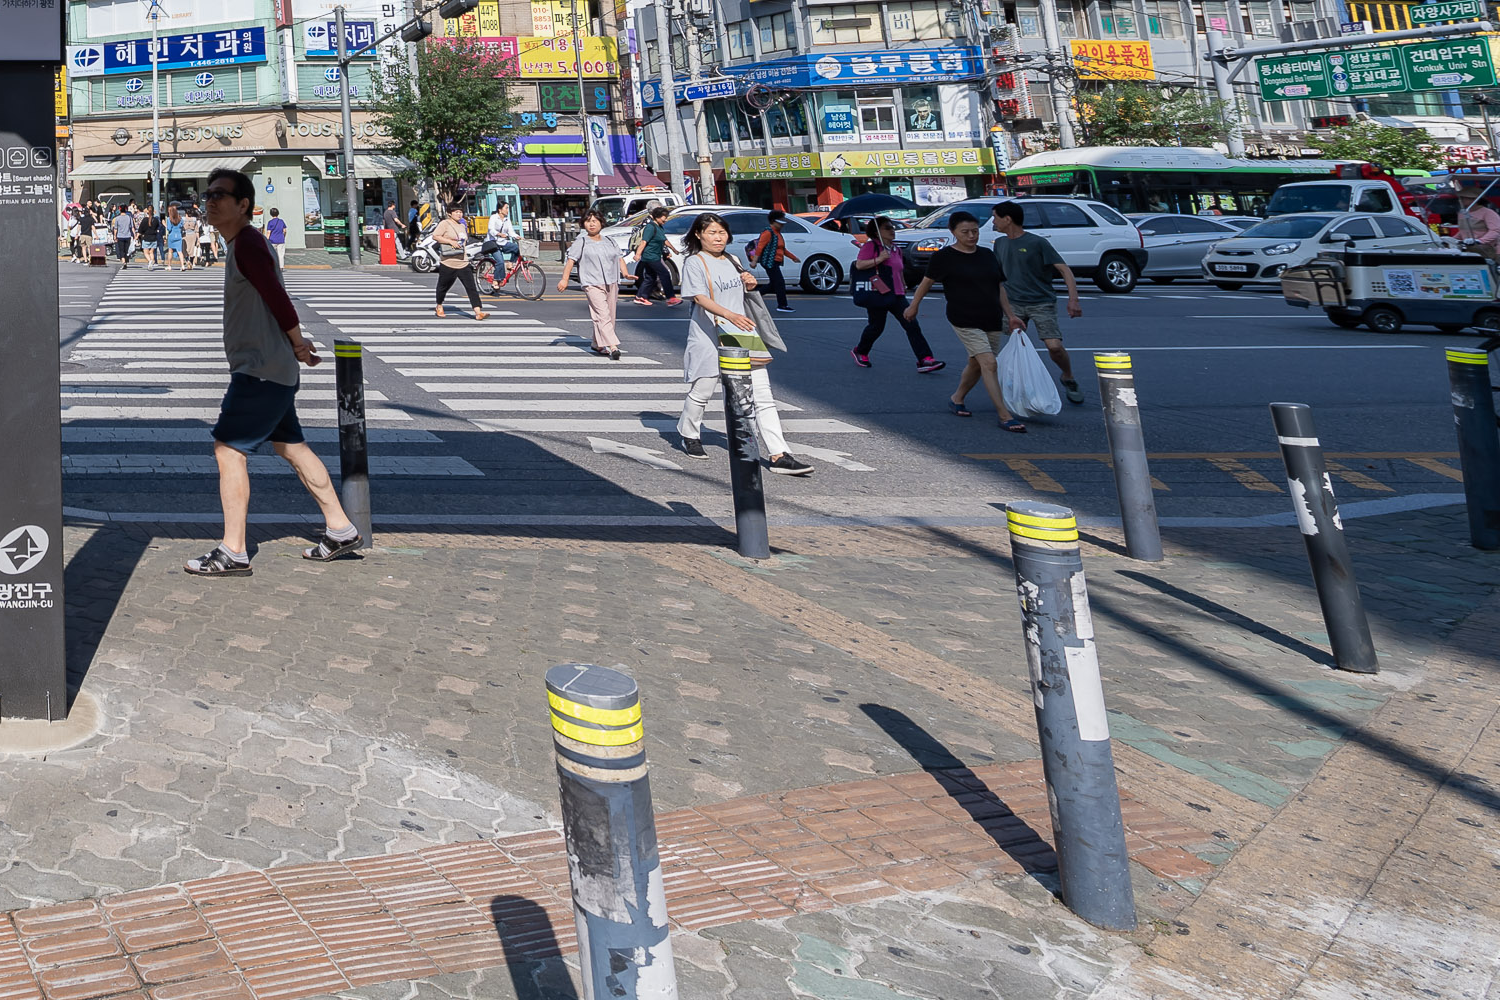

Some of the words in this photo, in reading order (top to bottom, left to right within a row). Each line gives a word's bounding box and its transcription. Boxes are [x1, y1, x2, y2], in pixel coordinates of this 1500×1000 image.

[2, 0, 39, 9] 가치더하기
[40, 0, 55, 9] 광진
[1413, 1, 1477, 20] 자양사거리
[481, 19, 499, 31] 4088
[1077, 43, 1150, 67] 성인용품점
[1349, 52, 1370, 64] 성남
[1409, 44, 1483, 62] 건대입구역
[1261, 59, 1323, 76] 동서울터미널
[1413, 63, 1445, 73] Konkuk
[1448, 61, 1468, 72] Univ
[1472, 59, 1488, 69] Stn
[1349, 69, 1402, 83] 잠실대교
[197, 125, 244, 143] JOURS
[288, 122, 332, 137] TOUS
[334, 122, 356, 137] ls
[748, 155, 811, 171] 시민동물병원
[865, 150, 980, 167] 시민동물병원
[12, 173, 32, 183] [Smart
[33, 173, 53, 183] shade]
[886, 167, 946, 176] T.456-4466
[24, 183, 54, 196] 그늘막
